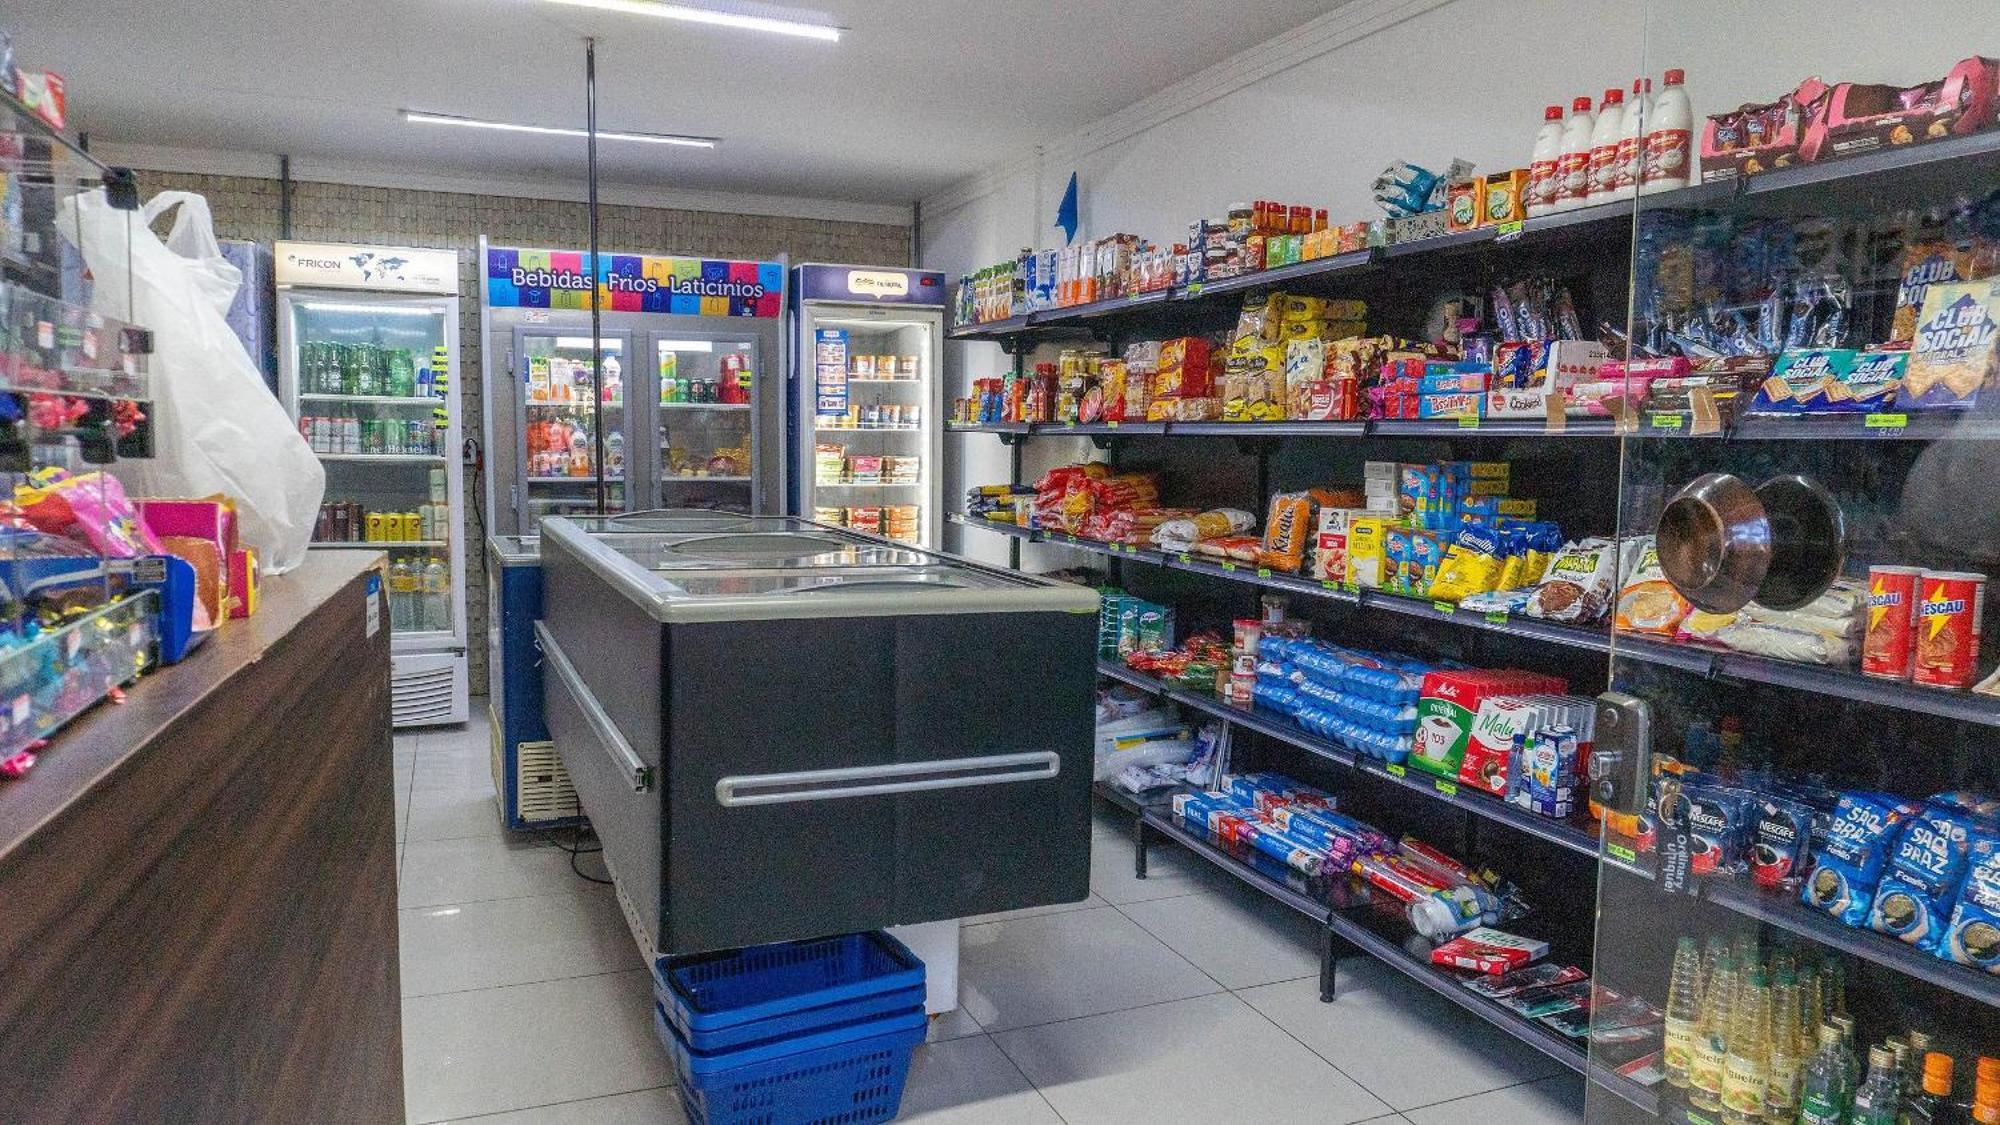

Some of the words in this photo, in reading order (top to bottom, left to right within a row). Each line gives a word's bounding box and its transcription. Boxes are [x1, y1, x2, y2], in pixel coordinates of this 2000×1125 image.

[298, 259, 341, 269] FRICON
[512, 268, 592, 290] Bebidas
[608, 273, 657, 293] Frios
[670, 276, 763, 299] Laticínios
[1932, 304, 1988, 330] CLUB
[1921, 601, 1964, 615] ESCAU
[1479, 711, 1515, 737] Malu
[1900, 842, 1949, 875] BRAZ
